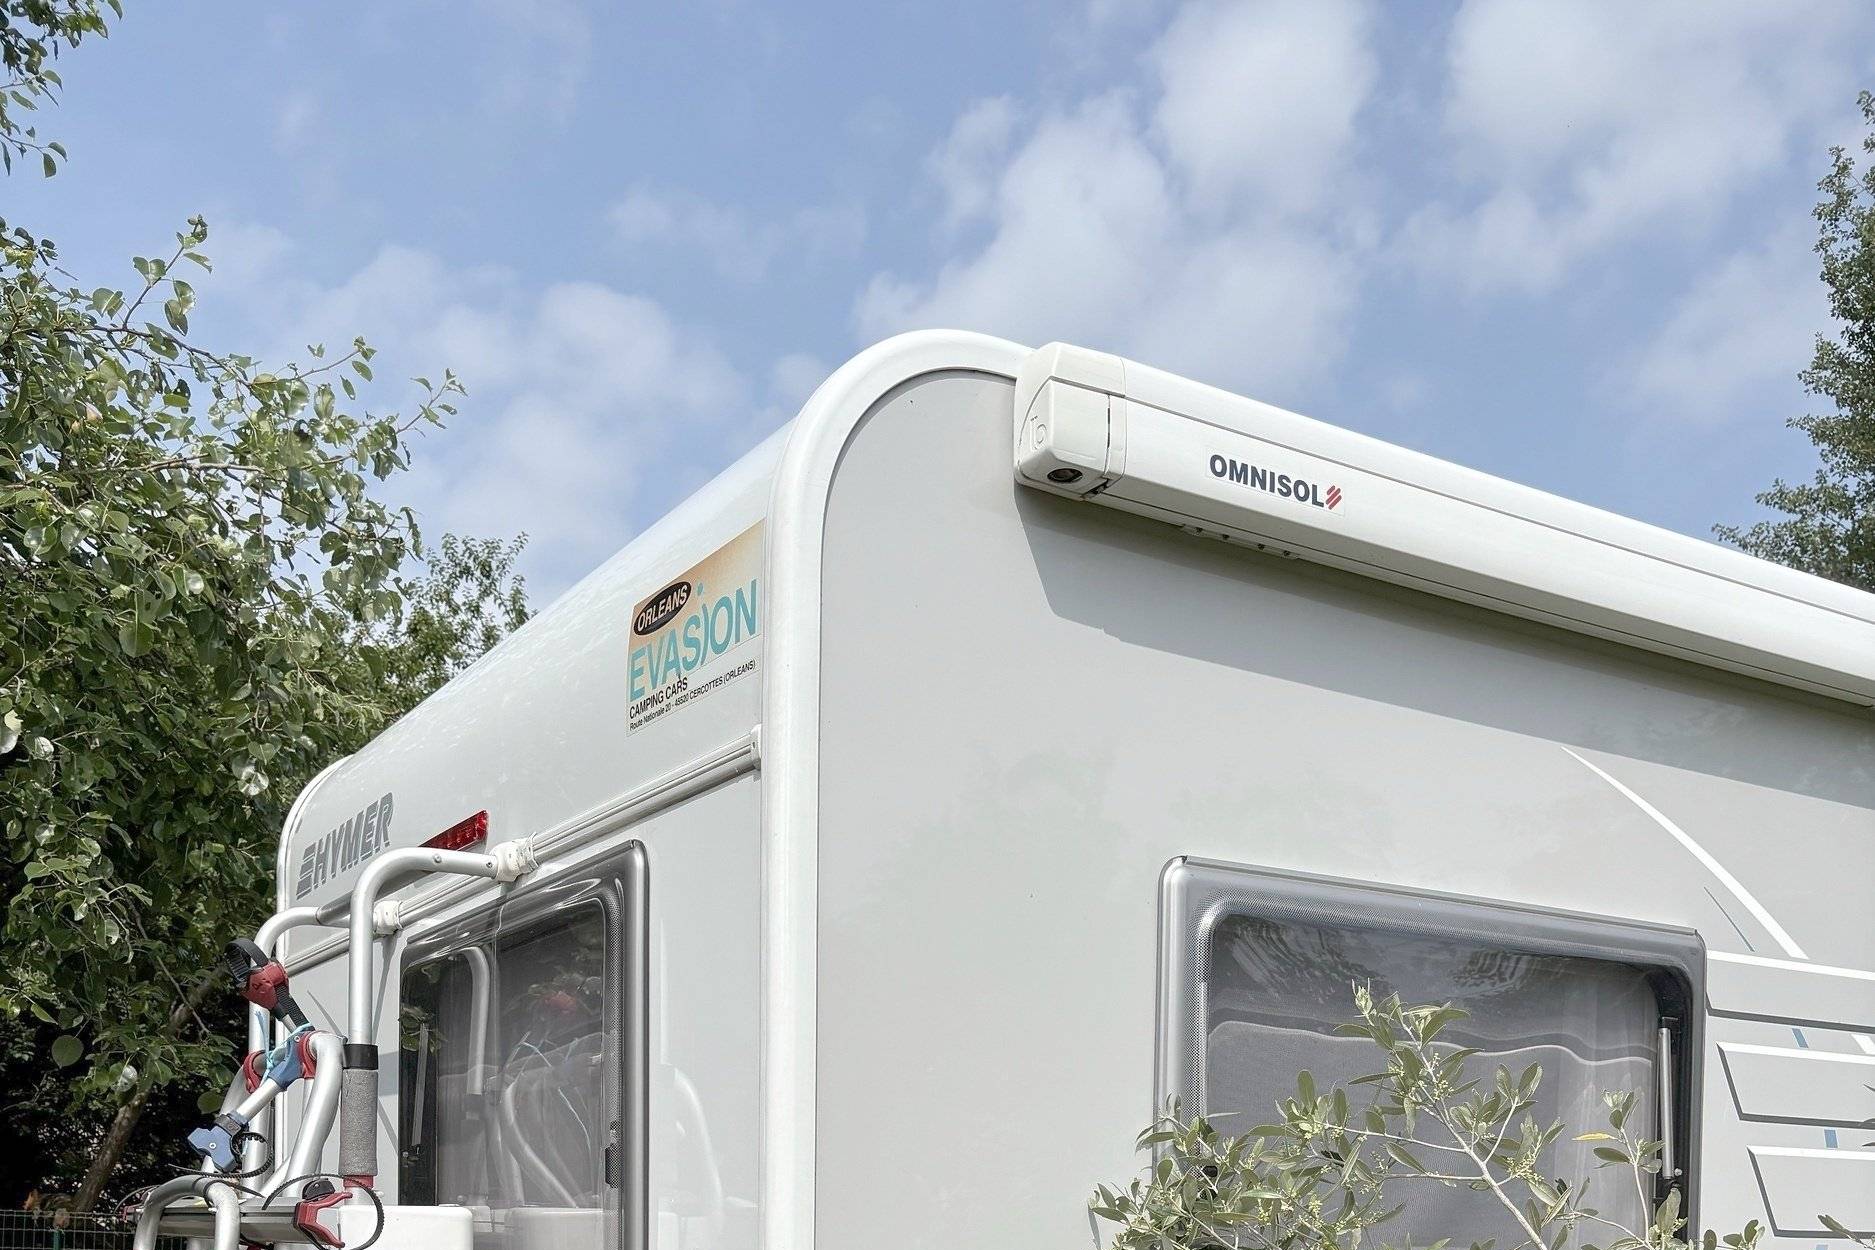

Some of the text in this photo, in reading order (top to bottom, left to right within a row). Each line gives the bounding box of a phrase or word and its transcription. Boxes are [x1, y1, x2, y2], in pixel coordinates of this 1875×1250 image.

[1209, 454, 1324, 507] OMNISOL
[637, 584, 688, 632] ORLEANS
[629, 677, 688, 719] CAMPING CARS
[630, 719, 643, 731] Route
[643, 707, 665, 724] Nationale
[665, 702, 672, 712] 20
[689, 676, 724, 700] CERCOTTES
[723, 659, 756, 685] (ORLEANS)
[311, 792, 394, 889] HYMER
